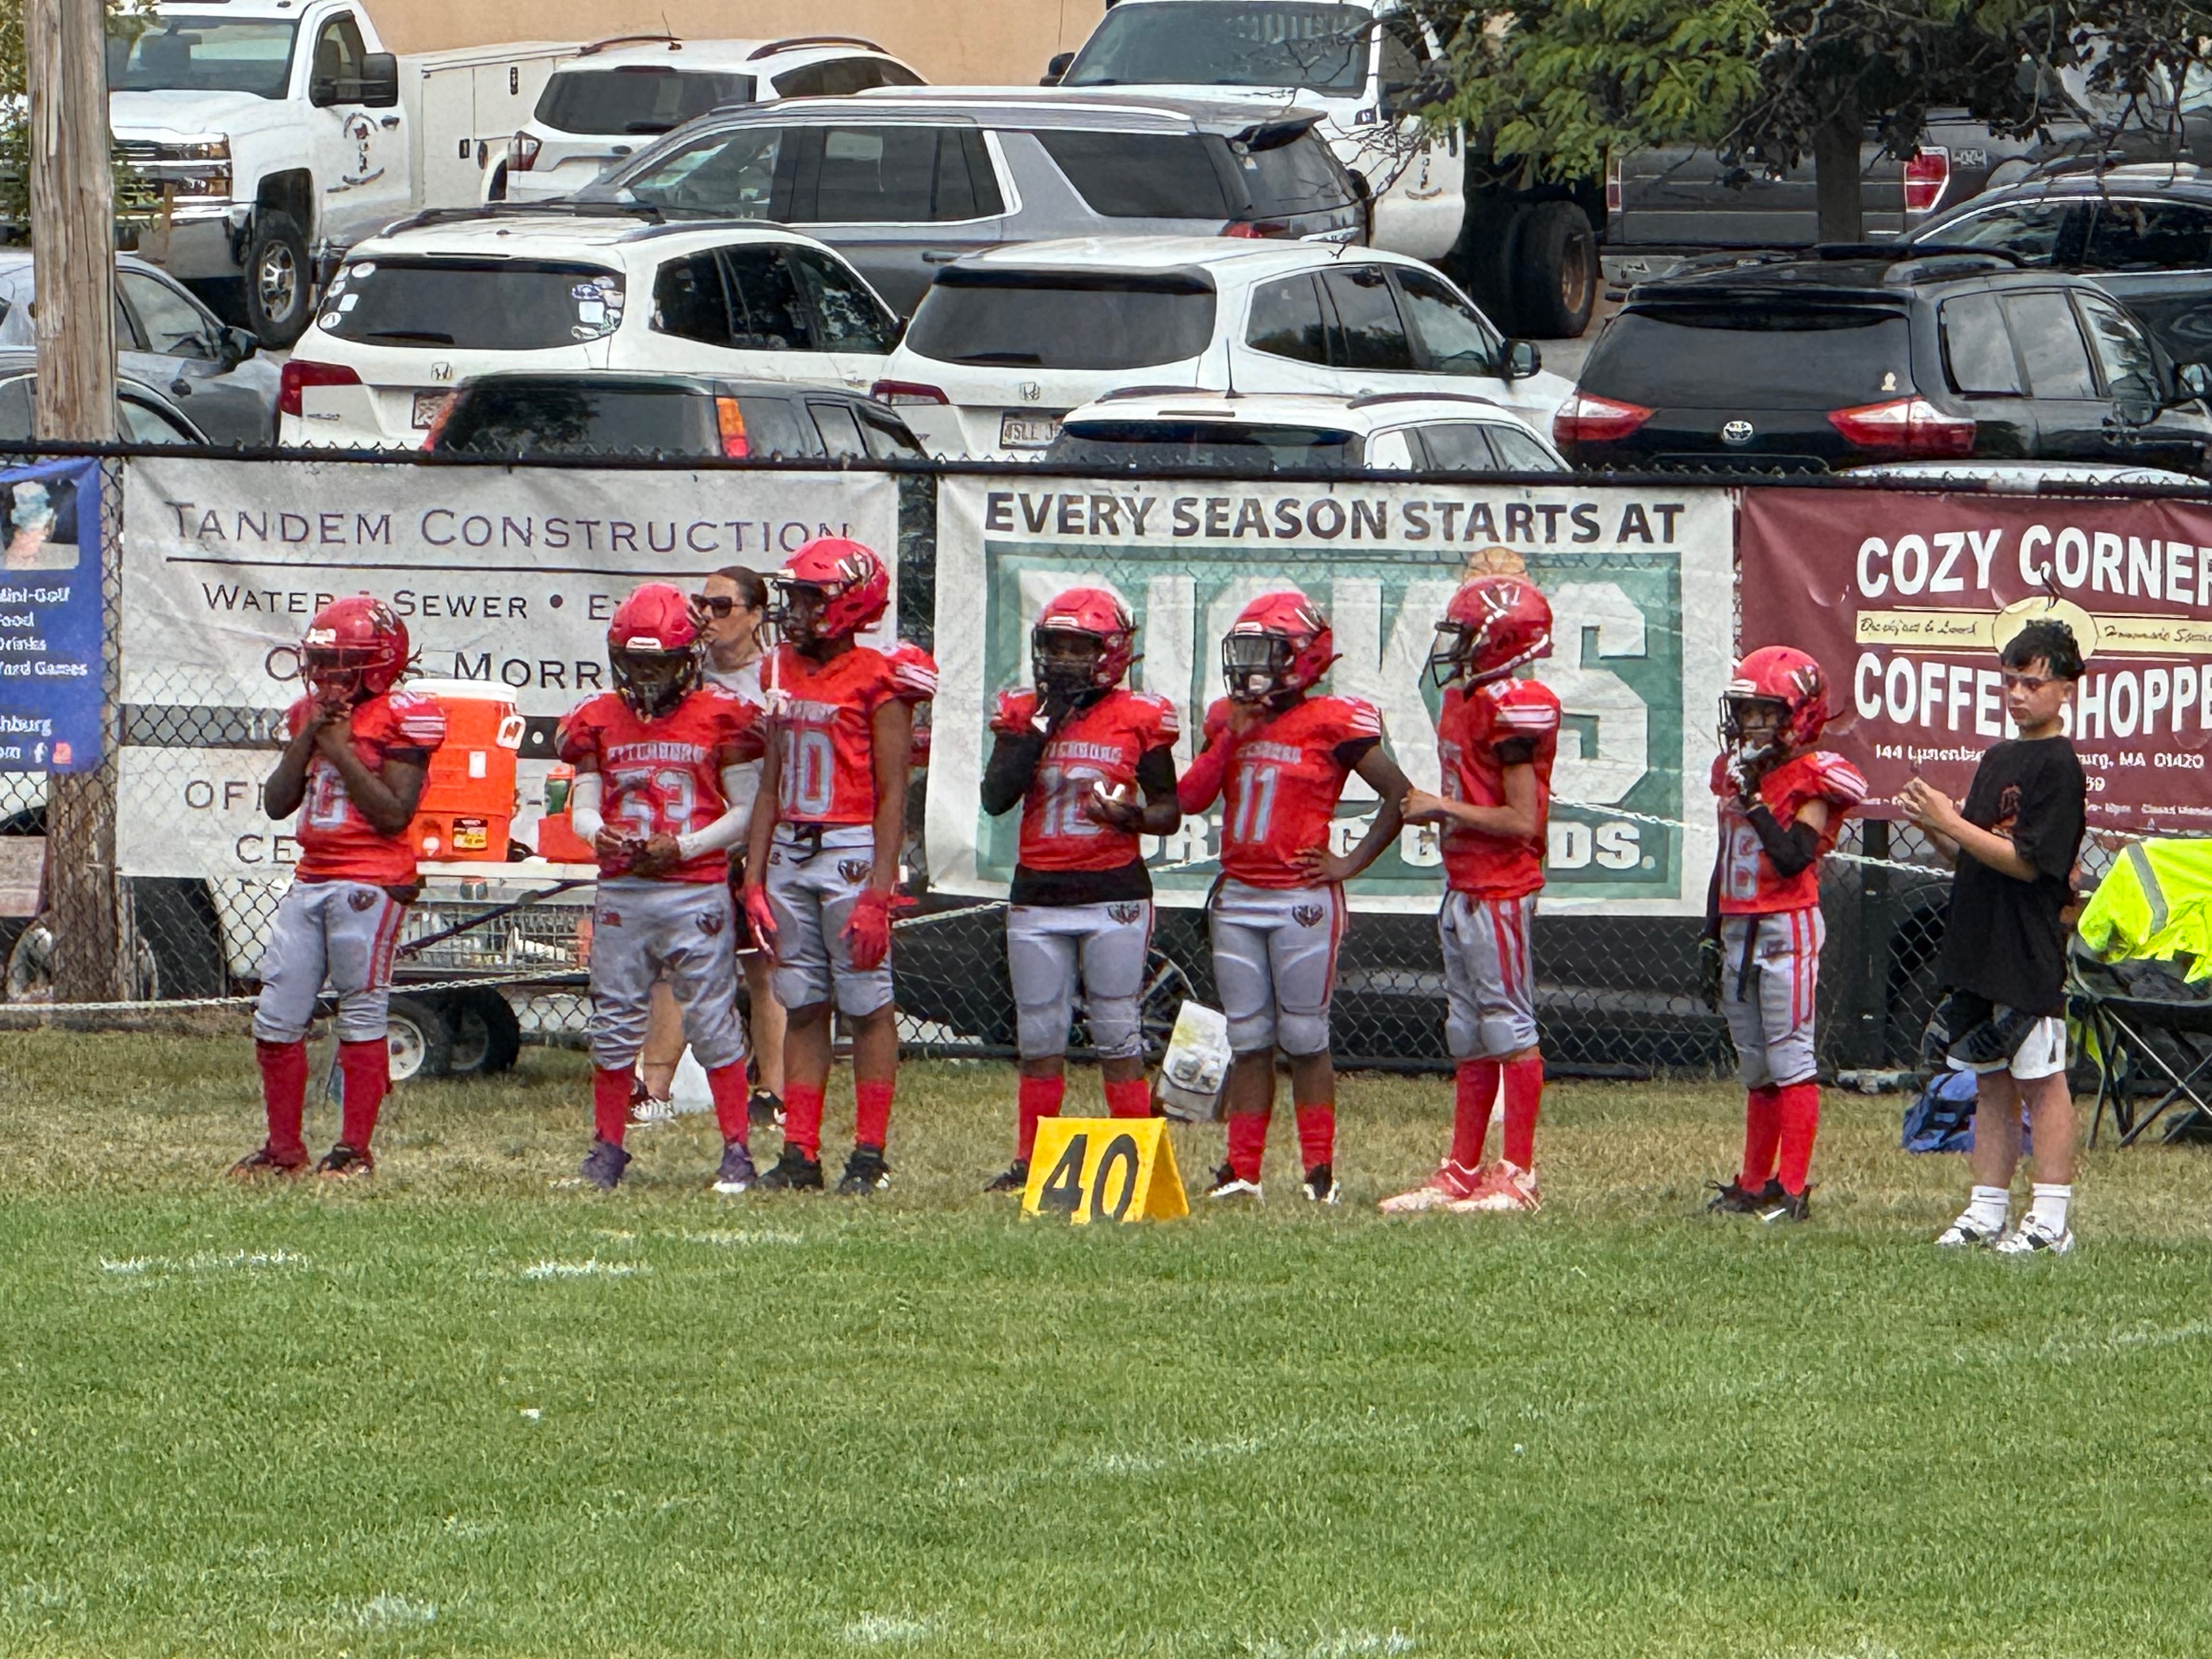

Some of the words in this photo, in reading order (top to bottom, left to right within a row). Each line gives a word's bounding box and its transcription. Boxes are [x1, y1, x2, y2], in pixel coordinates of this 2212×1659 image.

[165, 501, 392, 545] TANDEM
[986, 492, 1156, 536] EVERY
[1172, 498, 1387, 540] SEASON
[1402, 501, 1601, 543] STARTS
[1616, 503, 1685, 544] AT
[1857, 529, 2002, 598] COZY
[0, 611, 35, 627] ood
[393, 590, 528, 619] SEWER
[454, 652, 603, 689] MORR
[2059, 664, 2212, 741] HOPP
[0, 715, 52, 737] hburg
[2119, 751, 2146, 767] MA
[1234, 765, 1279, 844] 11
[1401, 821, 1656, 870] GDS.
[1038, 1133, 1139, 1221] 40
